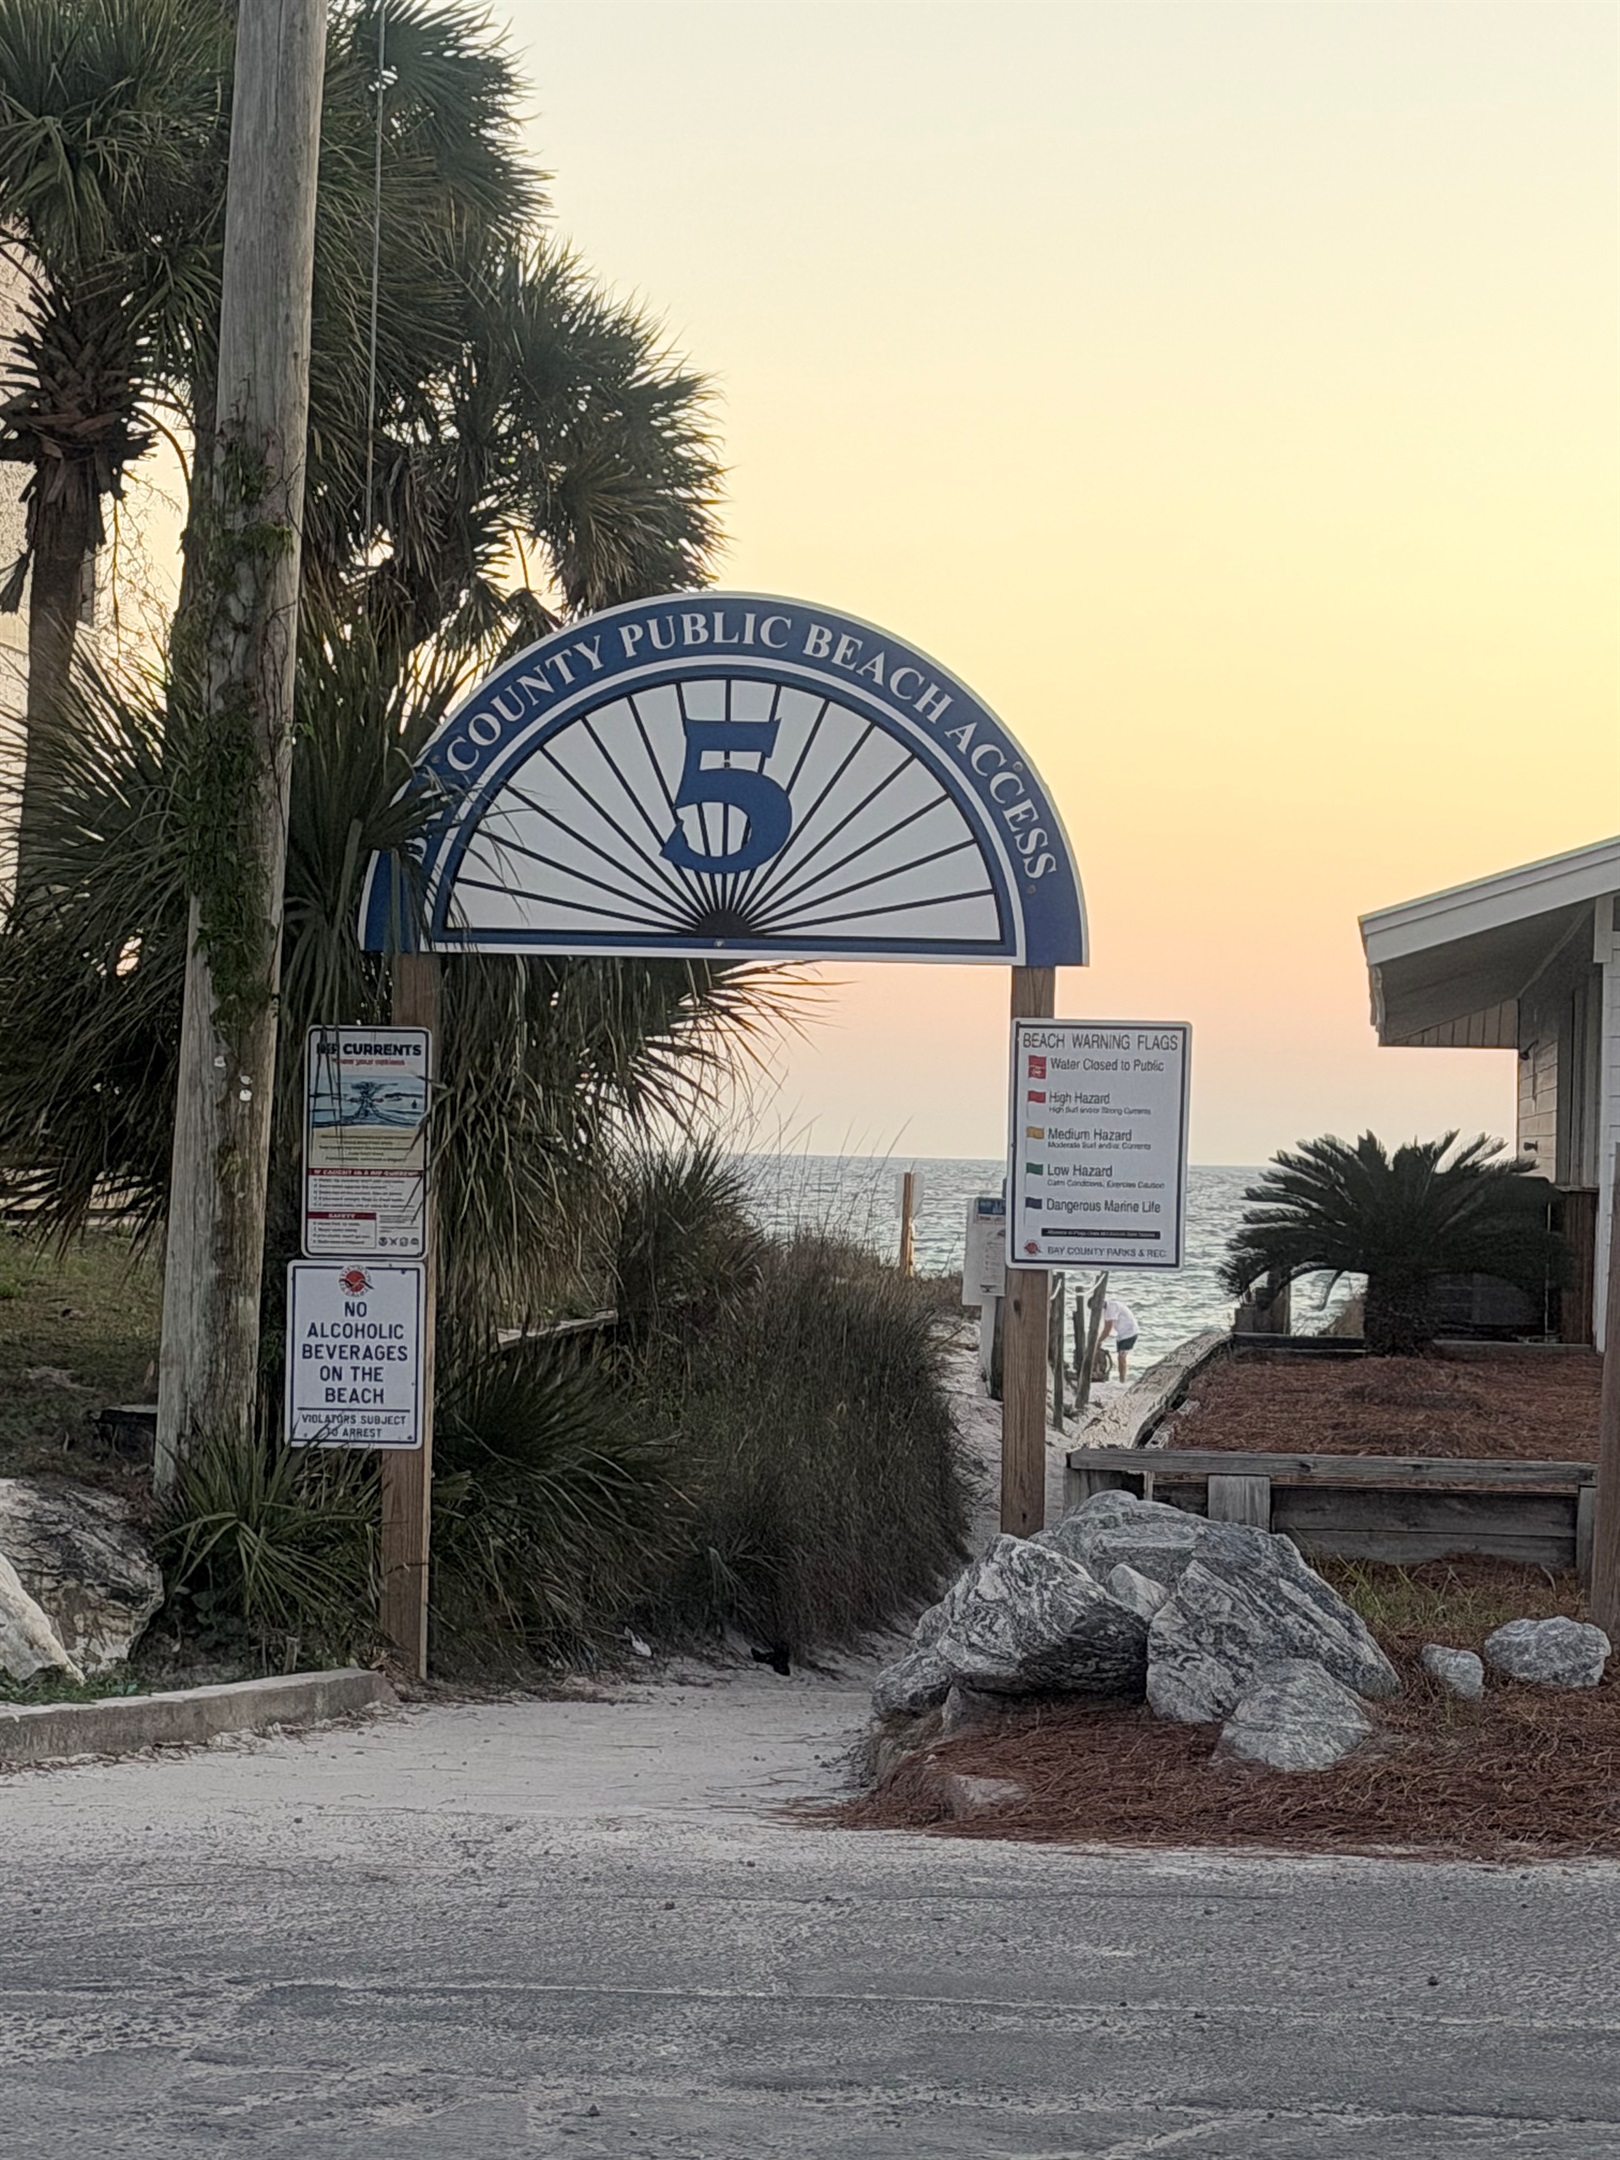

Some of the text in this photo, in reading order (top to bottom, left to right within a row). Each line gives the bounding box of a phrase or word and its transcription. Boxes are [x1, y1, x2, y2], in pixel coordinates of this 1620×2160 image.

[447, 612, 1057, 879] COUNTY PUBLIC BEACH ACCESS
[659, 716, 792, 874] 5
[343, 1043, 422, 1056] CURRENTS
[1023, 1033, 1178, 1051] BEACH WARNING FLAGS
[1050, 1057, 1164, 1072] Water Closed to Public
[1049, 1091, 1111, 1106] High Hazard
[1048, 1127, 1133, 1141] Medium Hazard
[1047, 1163, 1113, 1178] Low Hazard
[1046, 1198, 1161, 1214] Dangerous Marine Life
[1047, 1246, 1066, 1255] BAY
[1066, 1246, 1105, 1256] COUNTY
[1107, 1247, 1137, 1257] PARKS
[1137, 1248, 1145, 1257] &
[344, 1301, 367, 1318] NO
[307, 1322, 405, 1340] ALCOHOLIC
[302, 1343, 408, 1362] BEVERAGES
[319, 1365, 384, 1382] ON THE
[325, 1387, 385, 1404] BEACH
[302, 1413, 406, 1426] VIOLATORS SUBJECT
[342, 1428, 382, 1438] ARREST
